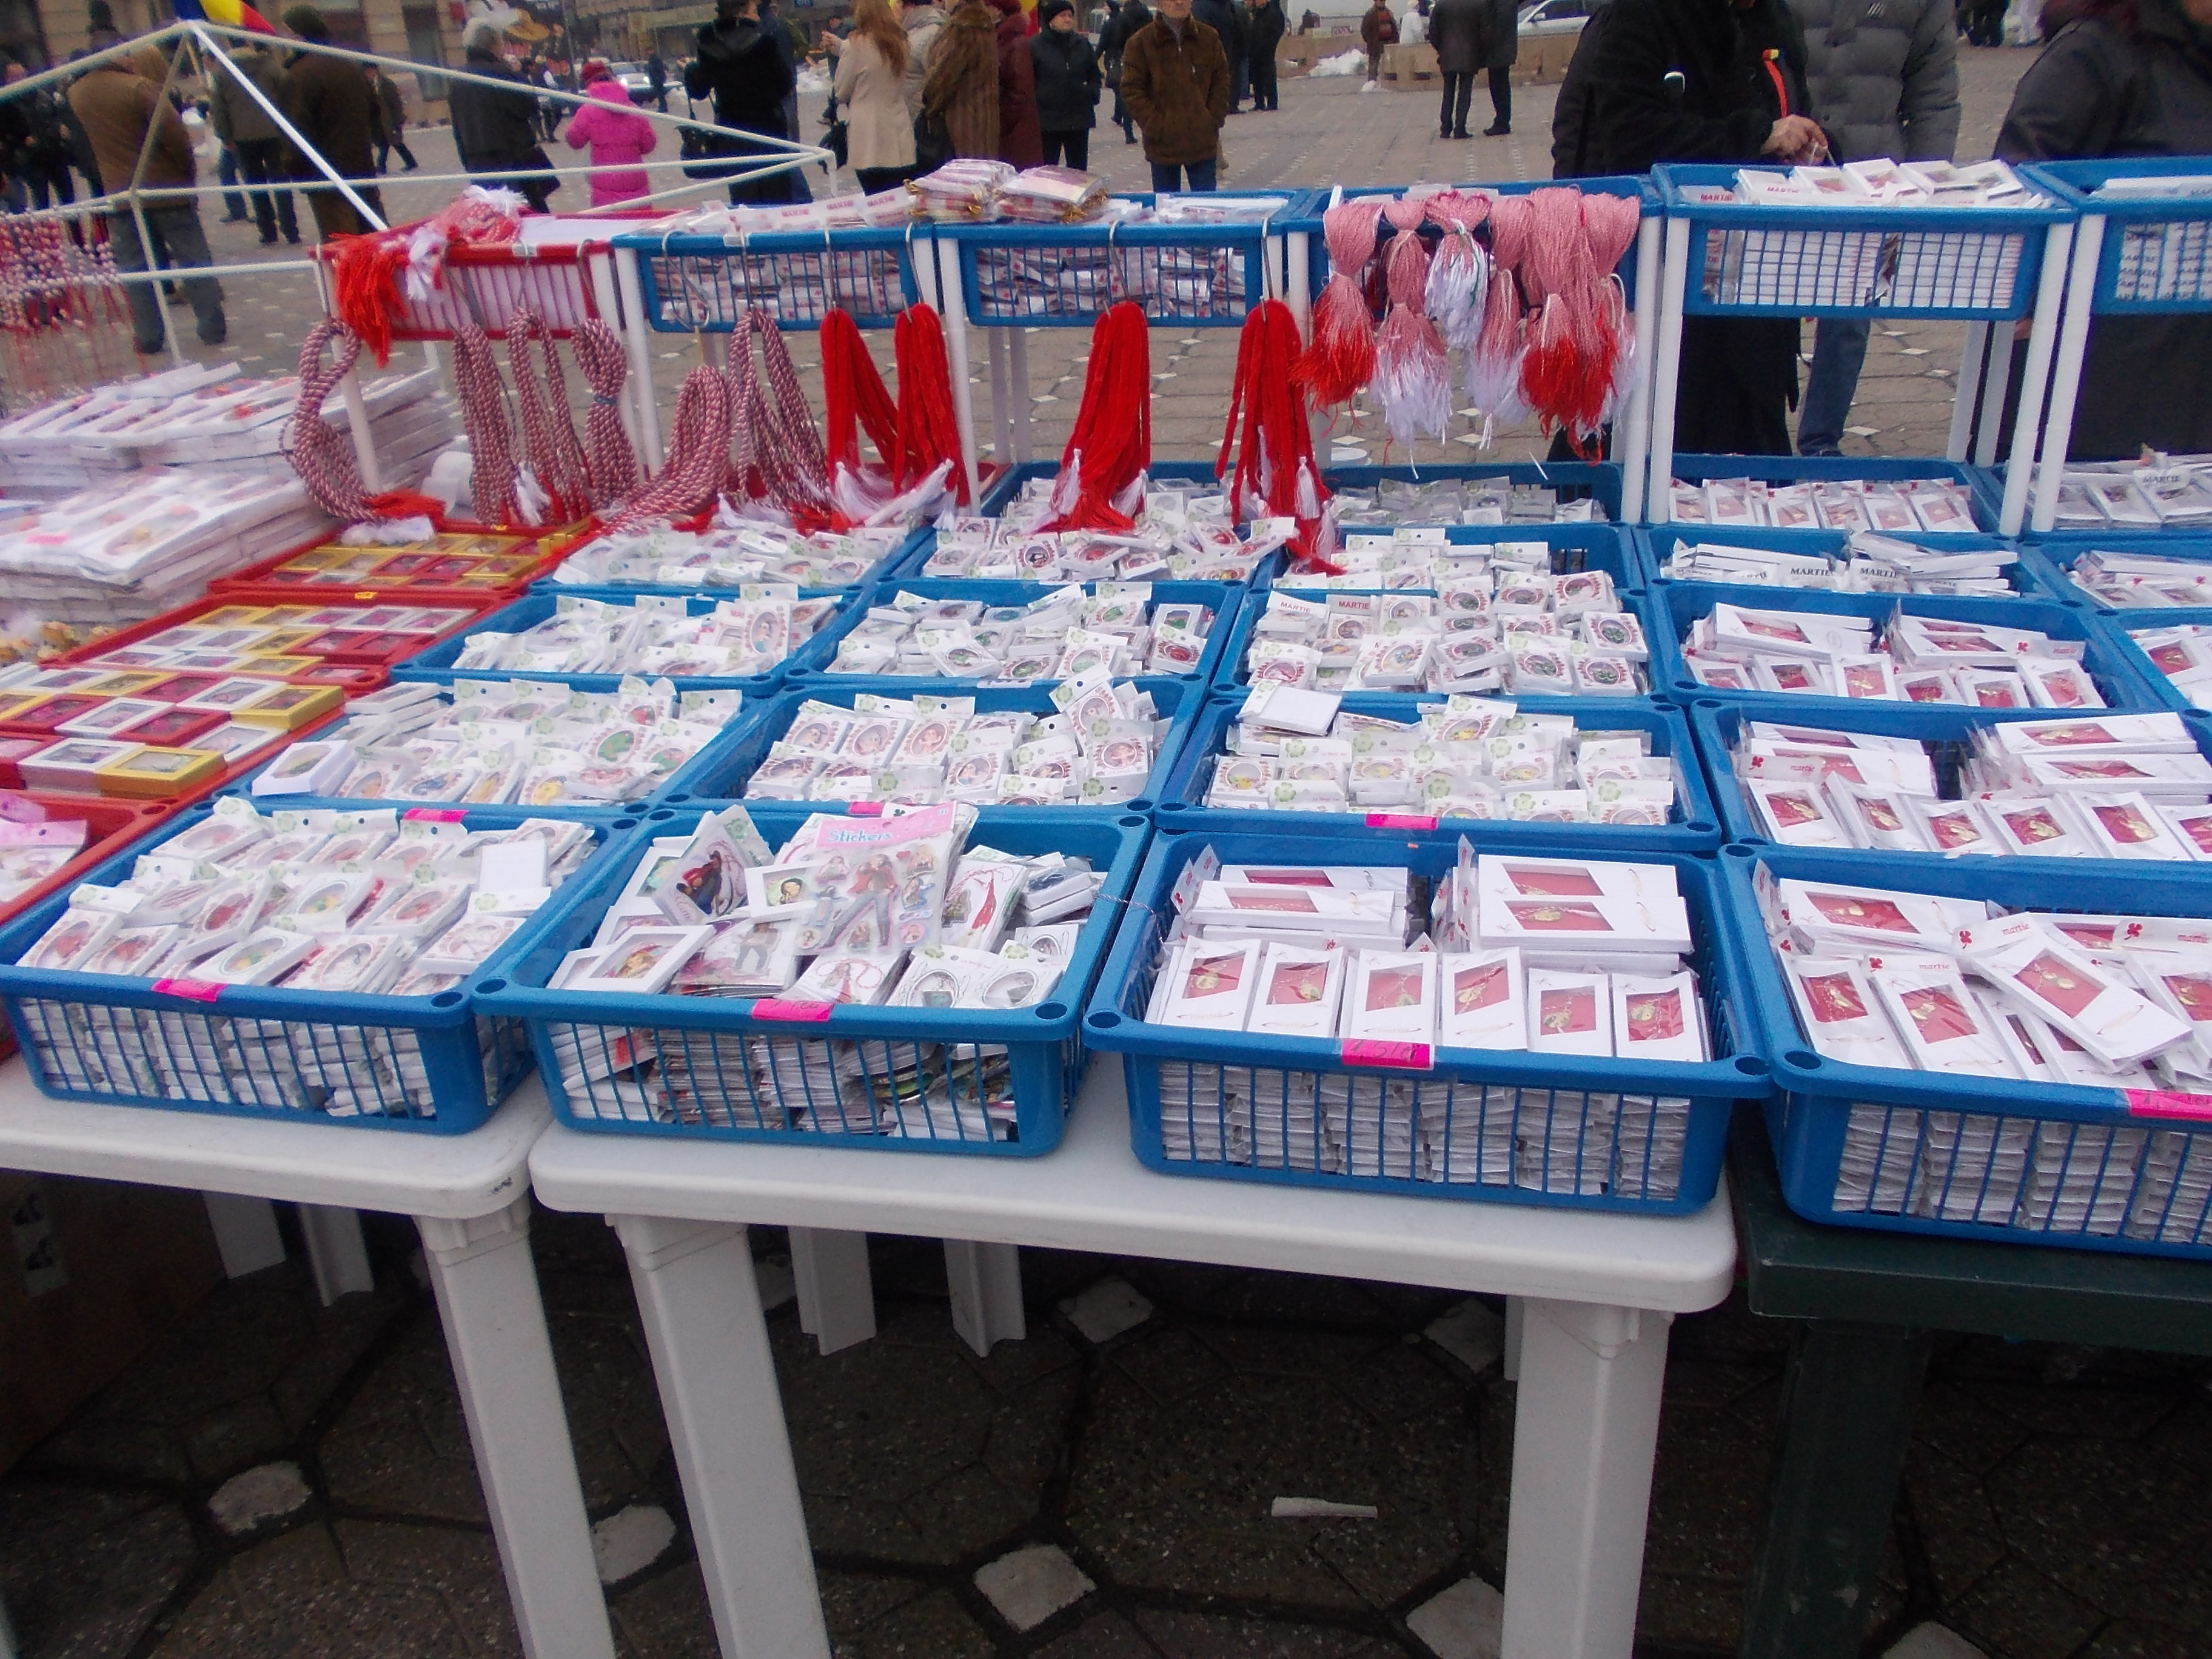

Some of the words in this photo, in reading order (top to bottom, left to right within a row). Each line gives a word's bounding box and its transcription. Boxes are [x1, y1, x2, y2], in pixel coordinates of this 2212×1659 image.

[1790, 568, 1831, 577] MARTIE
[1338, 601, 1370, 610] MARTIE
[828, 828, 893, 843] Stickers
[2002, 923, 2031, 936] martie
